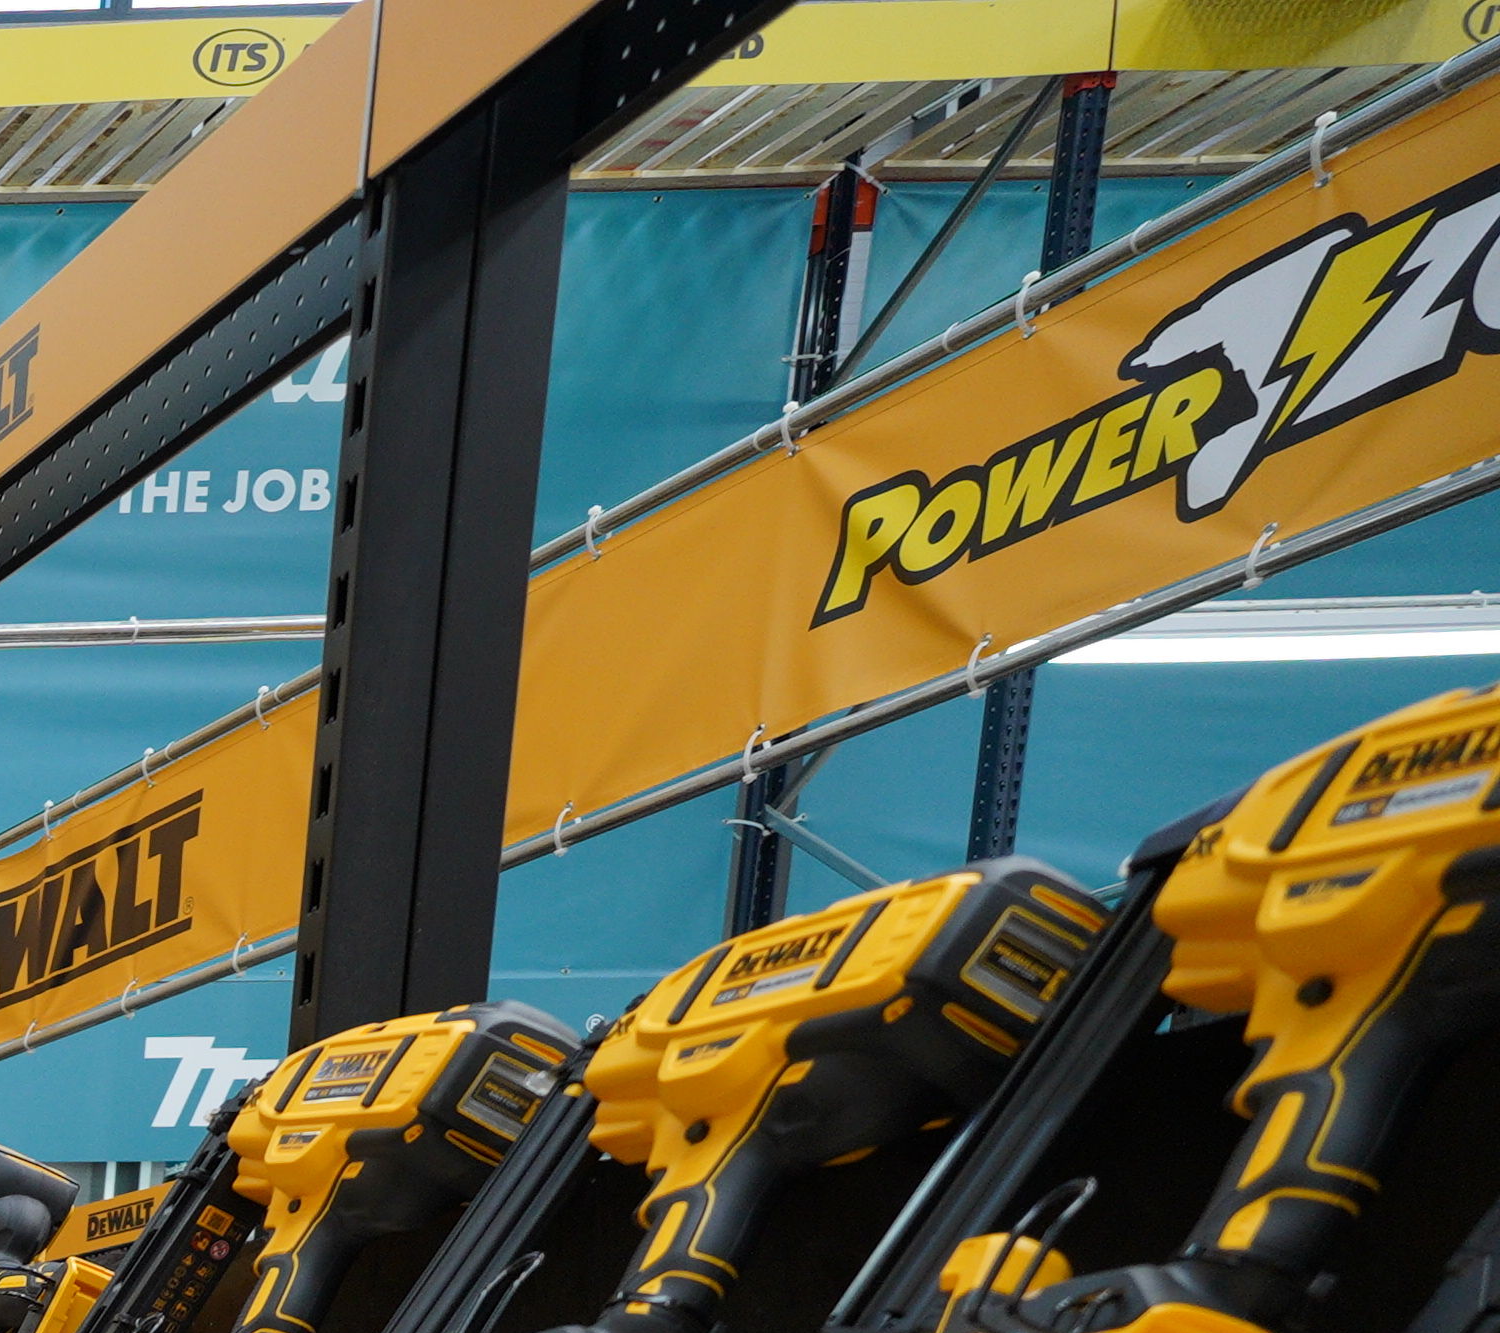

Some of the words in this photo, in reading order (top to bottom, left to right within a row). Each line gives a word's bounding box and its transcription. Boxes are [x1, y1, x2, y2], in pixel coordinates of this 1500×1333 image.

[209, 41, 268, 74] ITS
[117, 469, 209, 514] THE
[222, 467, 332, 514] JOB
[825, 369, 1222, 611] POWER
